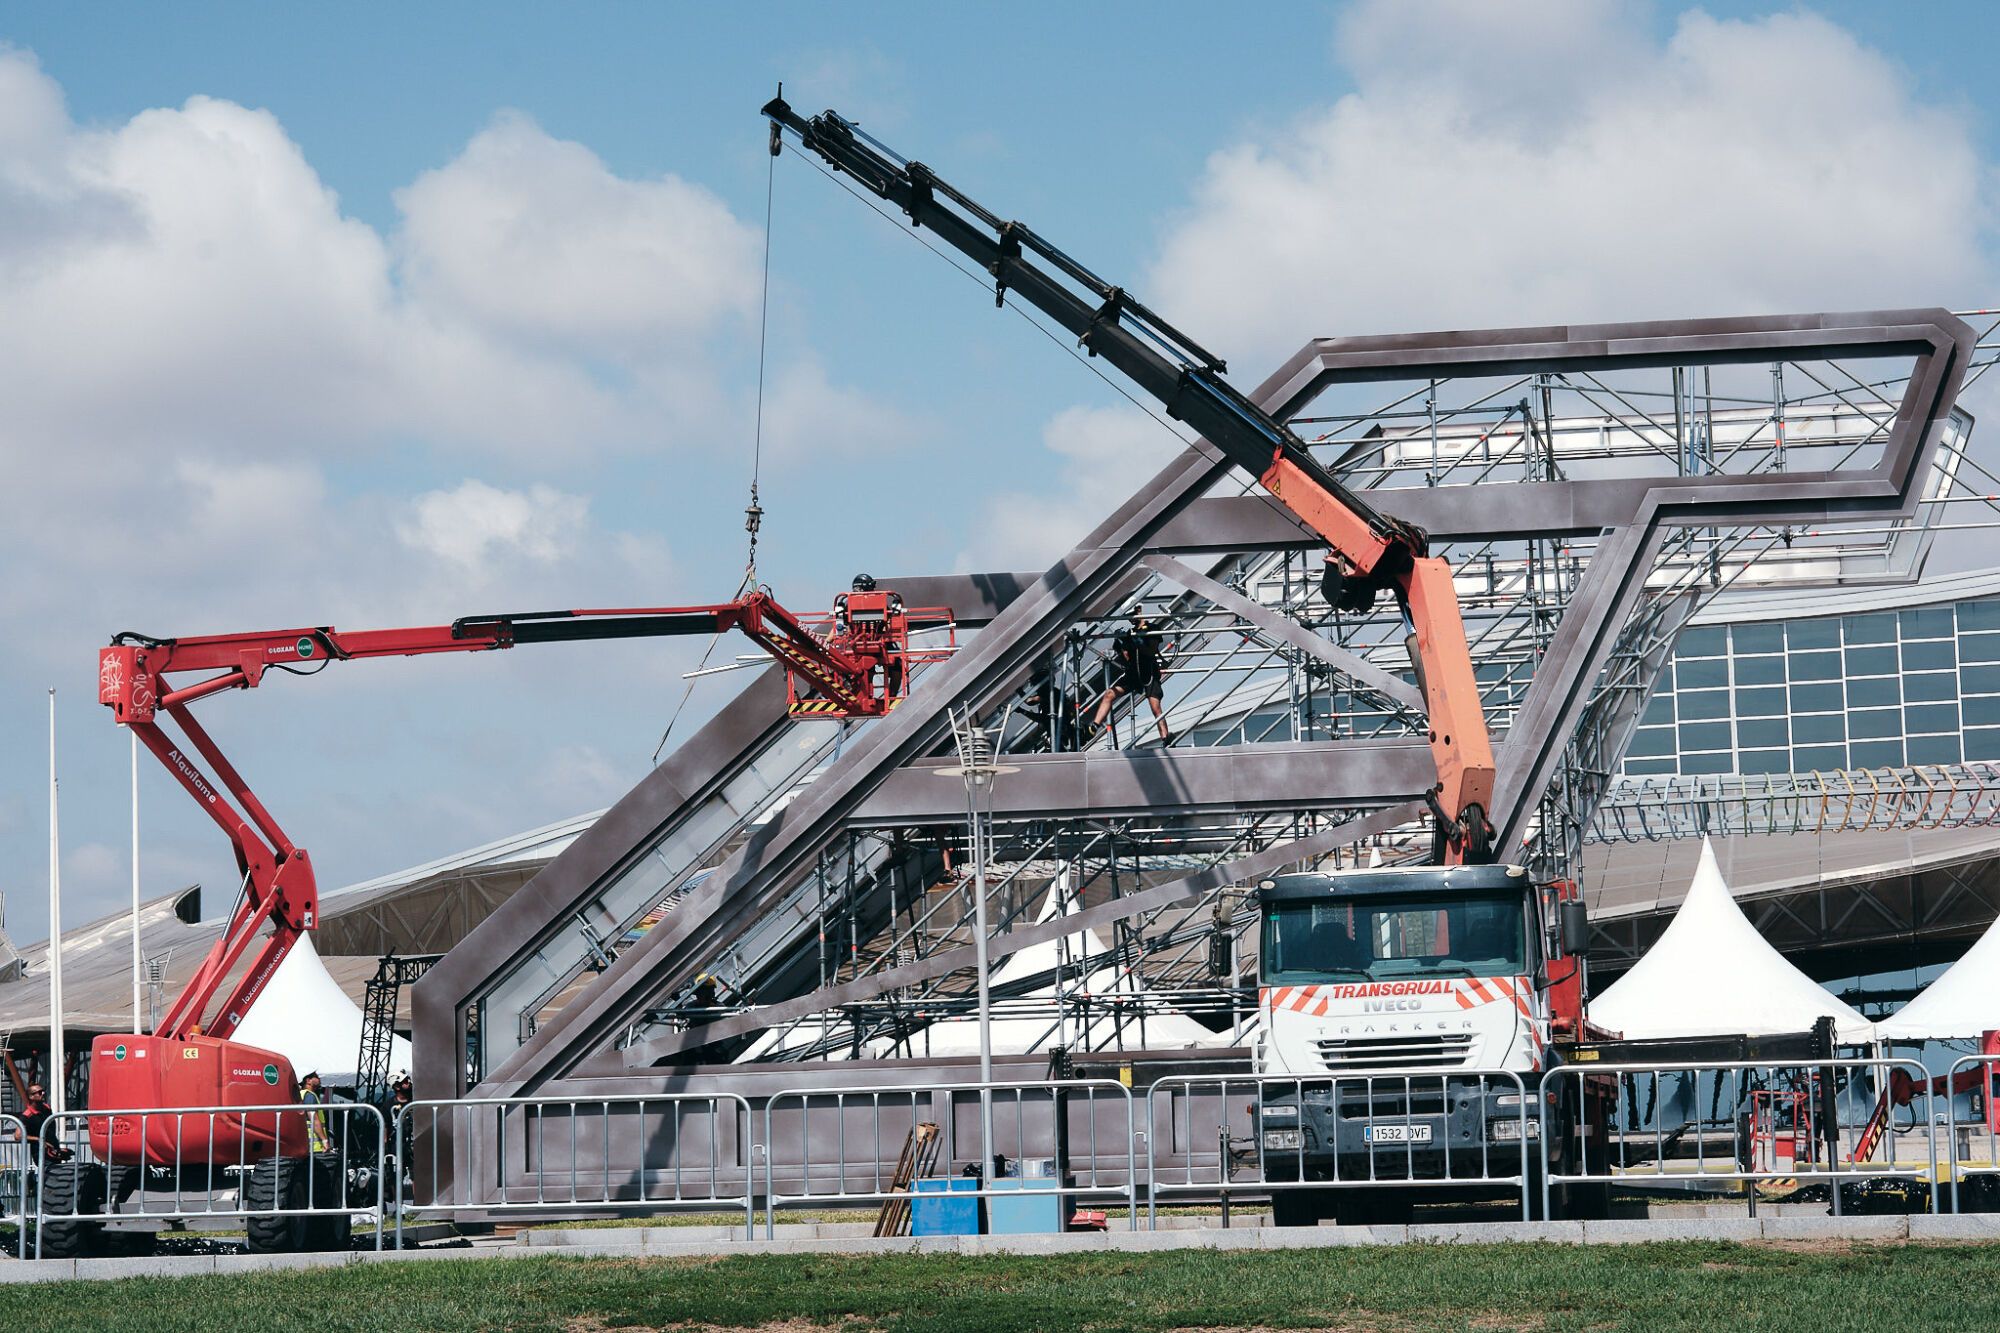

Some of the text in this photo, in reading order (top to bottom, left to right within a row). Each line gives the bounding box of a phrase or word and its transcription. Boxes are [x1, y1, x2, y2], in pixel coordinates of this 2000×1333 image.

[168, 750, 217, 804] Alquilame
[241, 946, 286, 1004] loxamhune.com
[1332, 981, 1454, 999] TRANSGRUAL
[1364, 999, 1422, 1012] IVECO
[1317, 1020, 1473, 1035] TRAKKER
[1376, 1128, 1402, 1140] 1532
